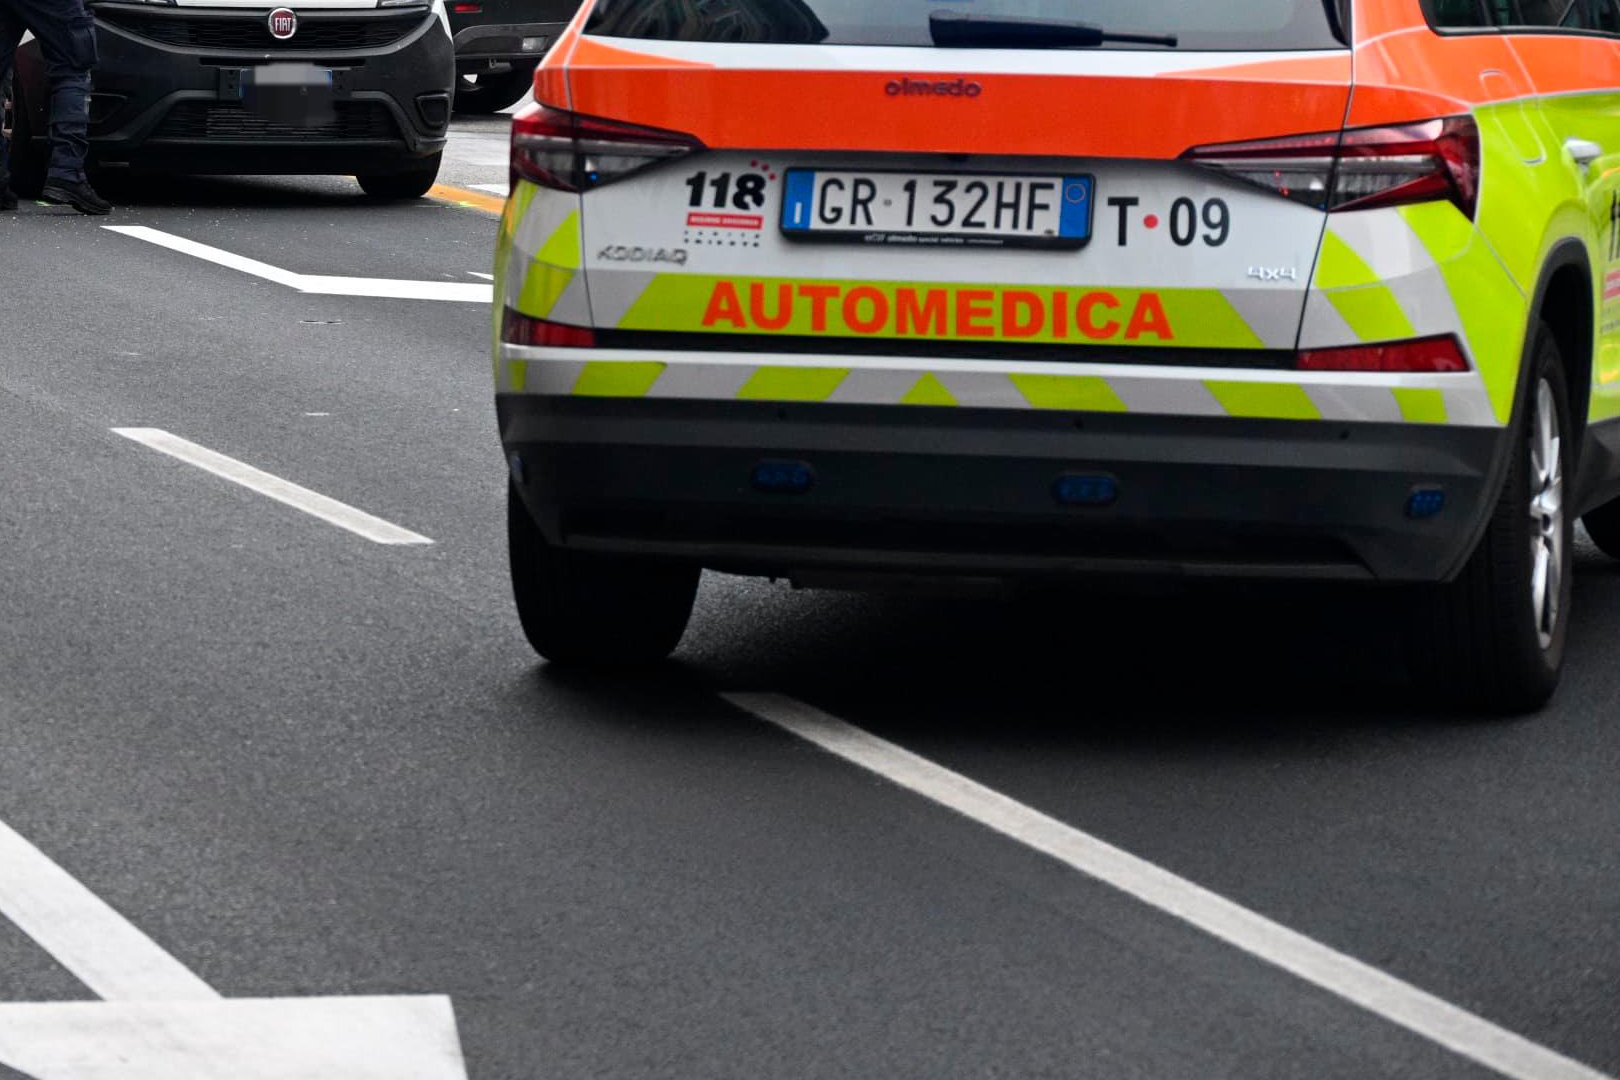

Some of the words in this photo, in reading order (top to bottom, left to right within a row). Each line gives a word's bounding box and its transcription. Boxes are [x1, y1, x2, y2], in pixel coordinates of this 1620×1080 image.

[275, 17, 292, 32] FIAT
[884, 76, 982, 97] olmedo
[685, 170, 766, 211] 118
[818, 177, 877, 225] GR
[597, 245, 687, 266] KODIAQ
[702, 279, 1175, 341] AUTOMEDICA
